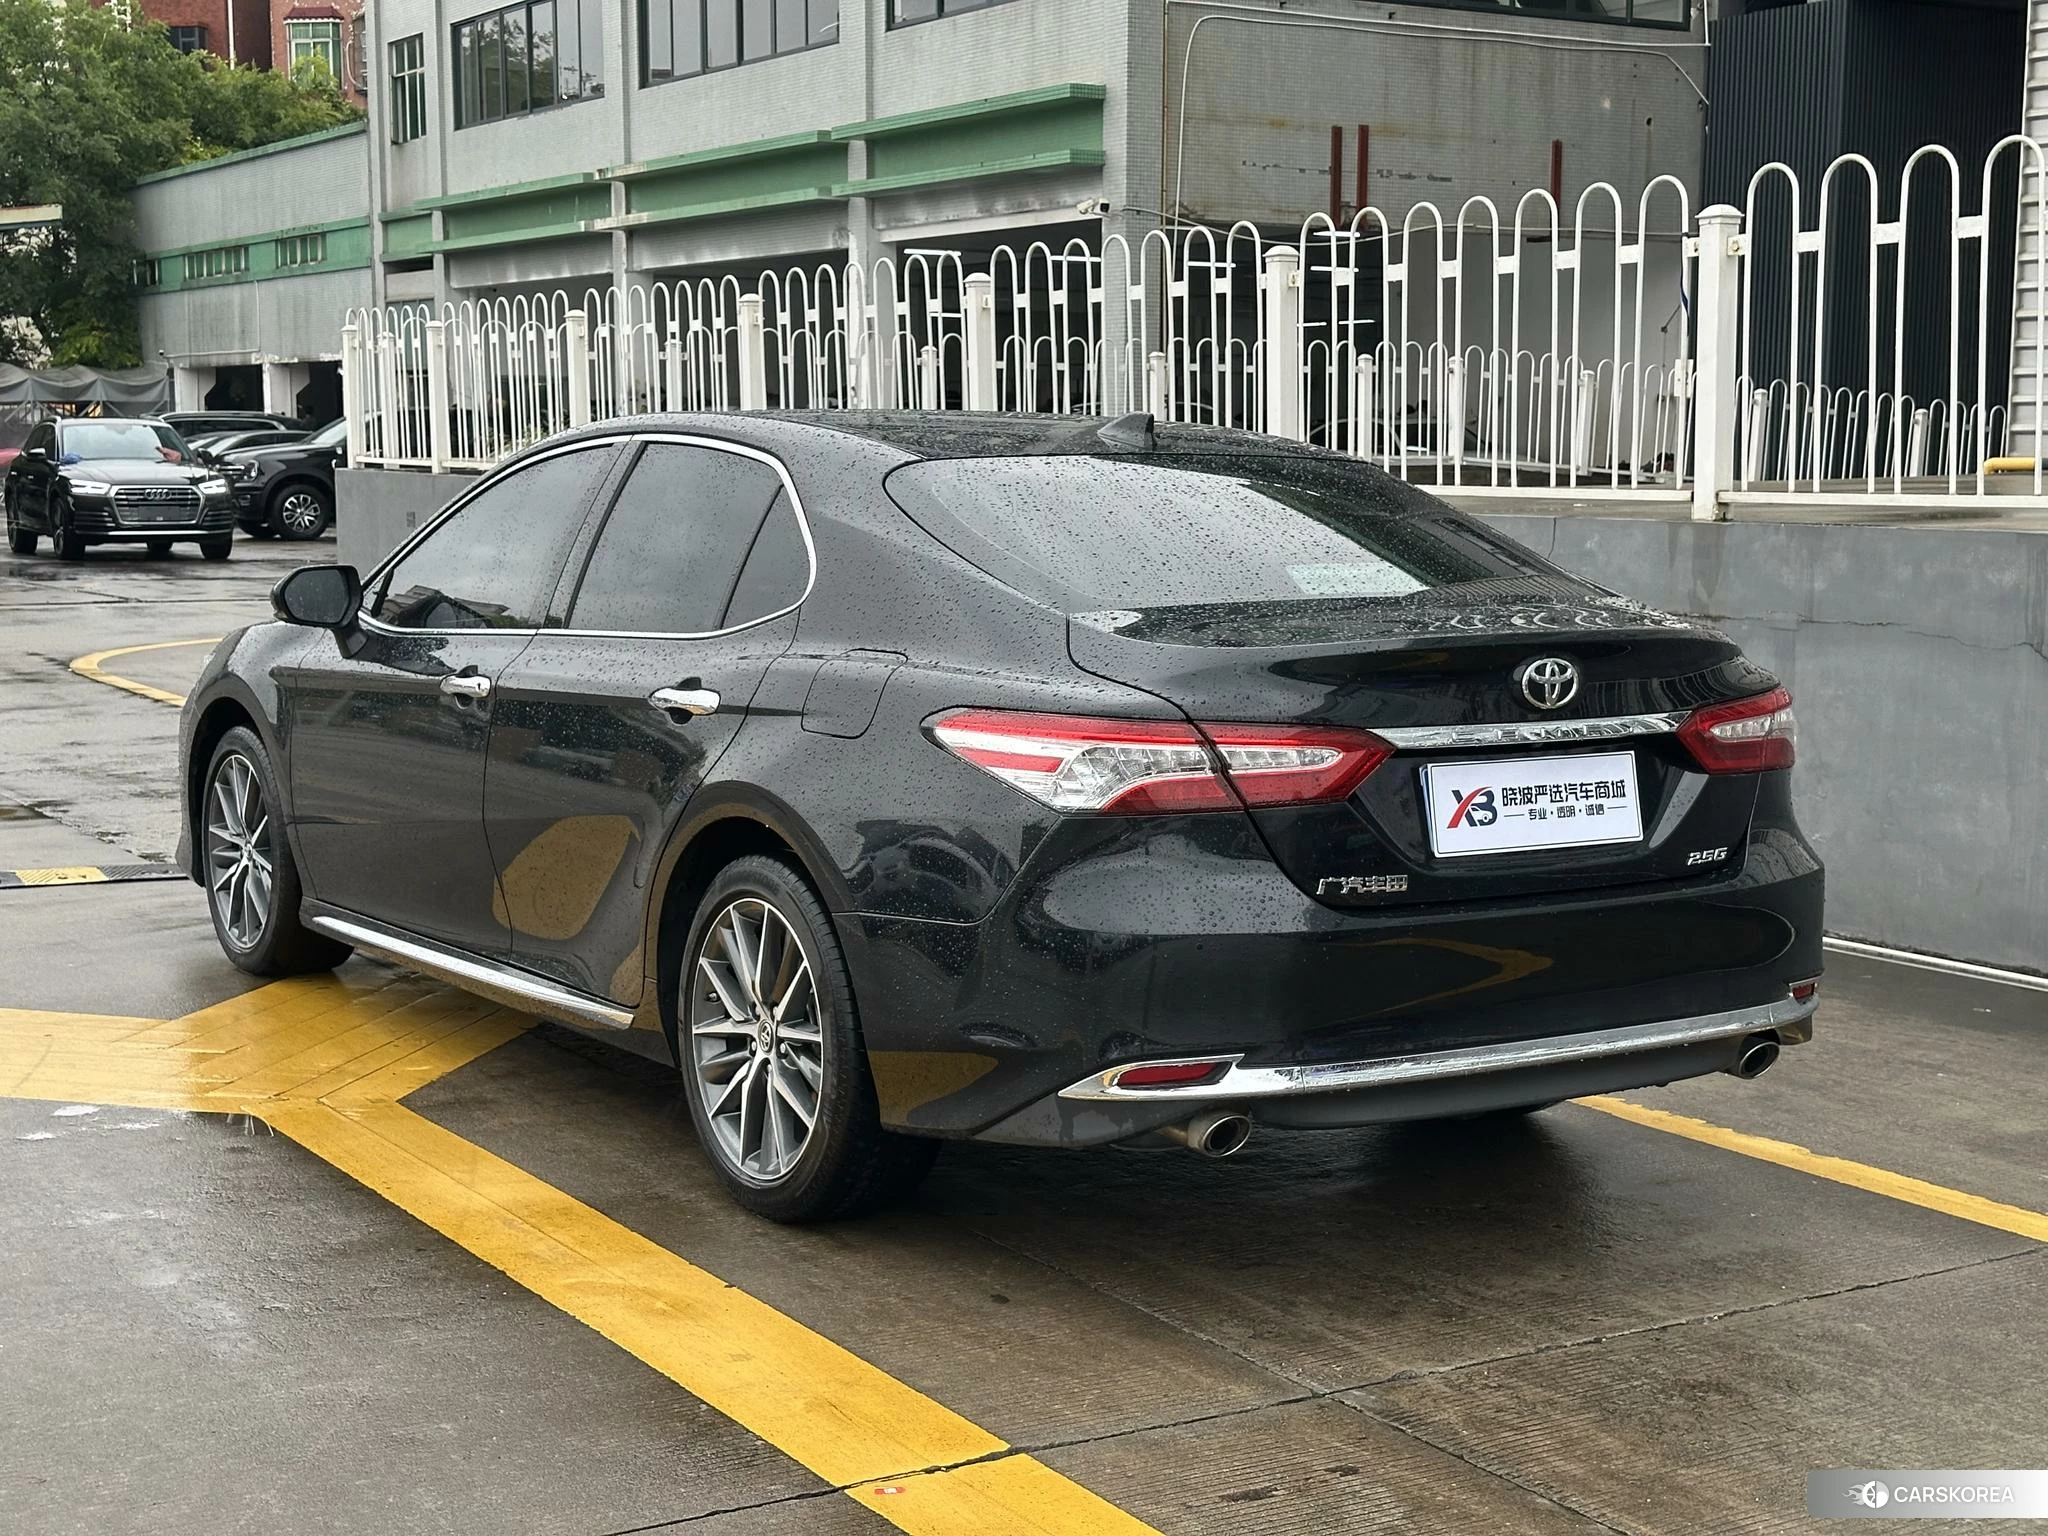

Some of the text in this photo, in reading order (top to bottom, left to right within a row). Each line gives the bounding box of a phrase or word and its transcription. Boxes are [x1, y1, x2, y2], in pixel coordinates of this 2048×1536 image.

[1501, 779, 1627, 807] 晓波严选汽车商城
[1316, 874, 1408, 895] 广汽丰田
